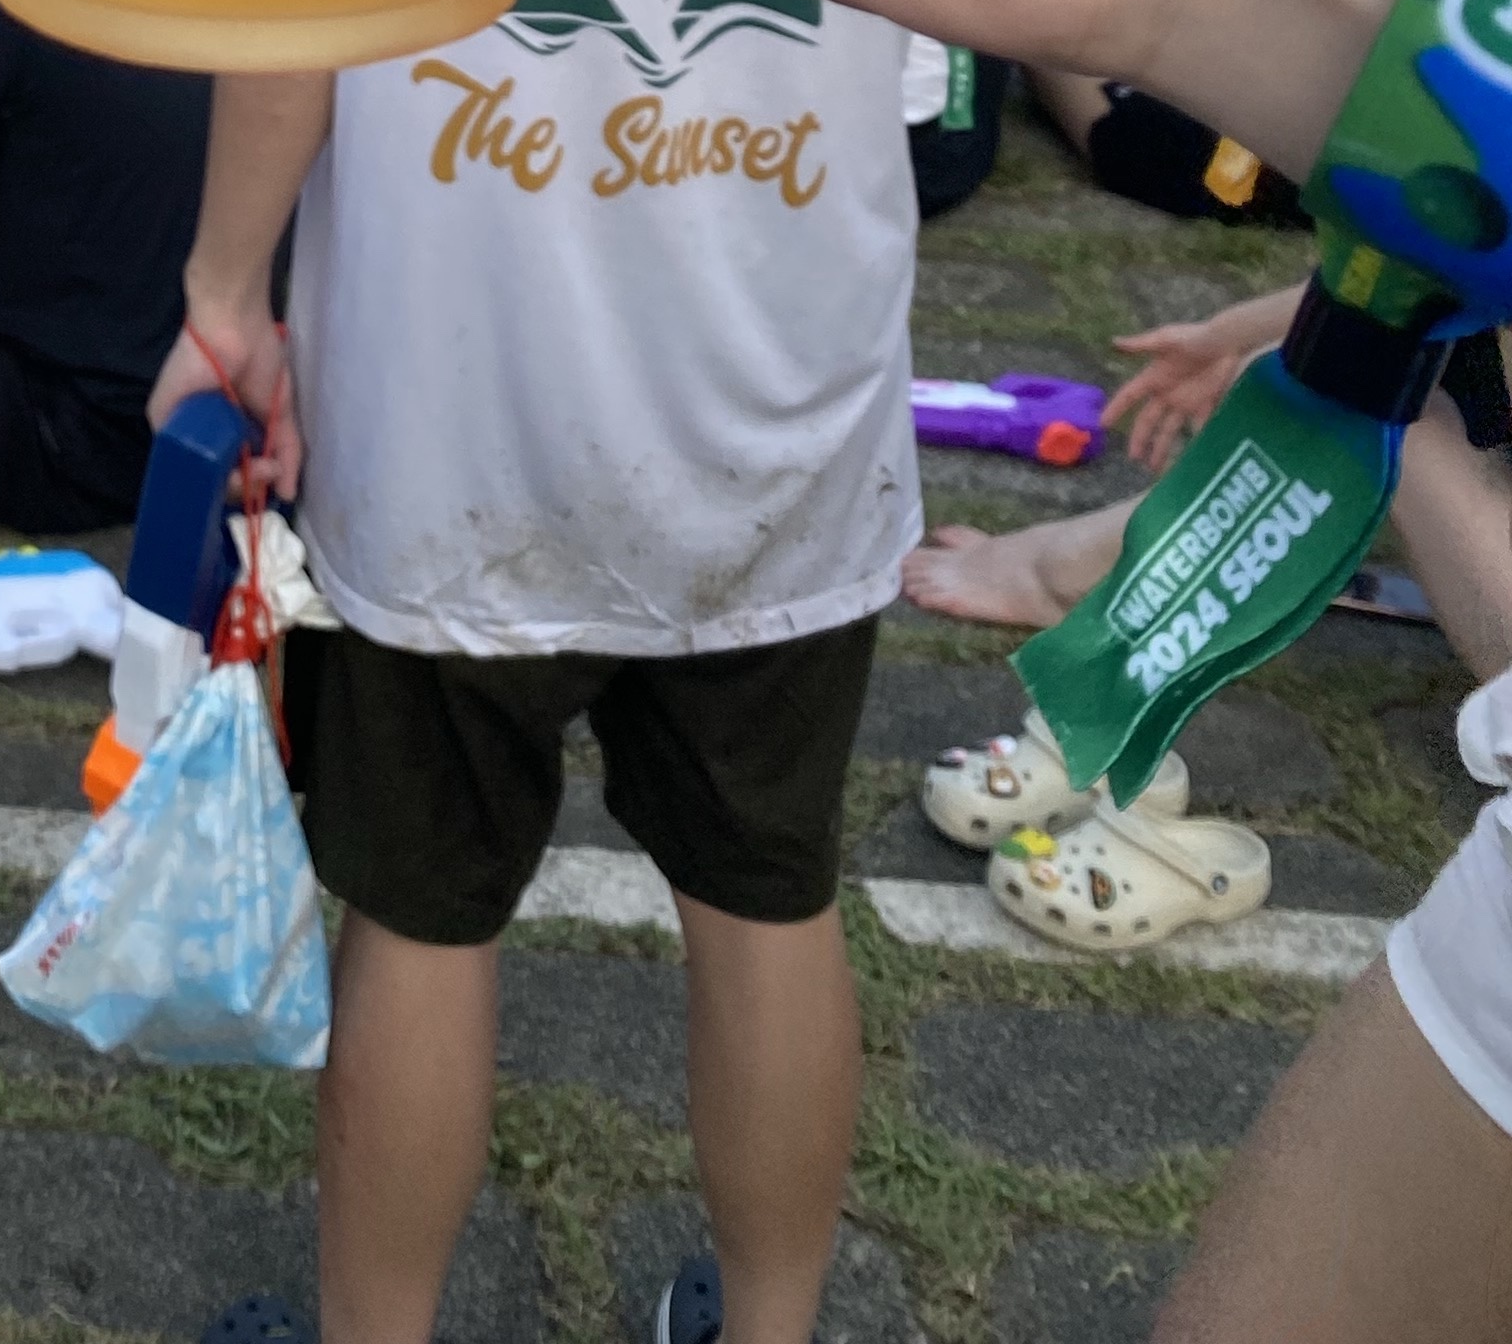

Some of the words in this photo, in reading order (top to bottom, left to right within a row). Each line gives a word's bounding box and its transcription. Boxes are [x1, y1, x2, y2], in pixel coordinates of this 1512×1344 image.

[411, 58, 563, 193] The
[592, 94, 827, 208] Sunset
[1117, 458, 1271, 630] WATERBOMB
[1125, 587, 1231, 697] 2024
[1219, 478, 1333, 605] SEOUL
